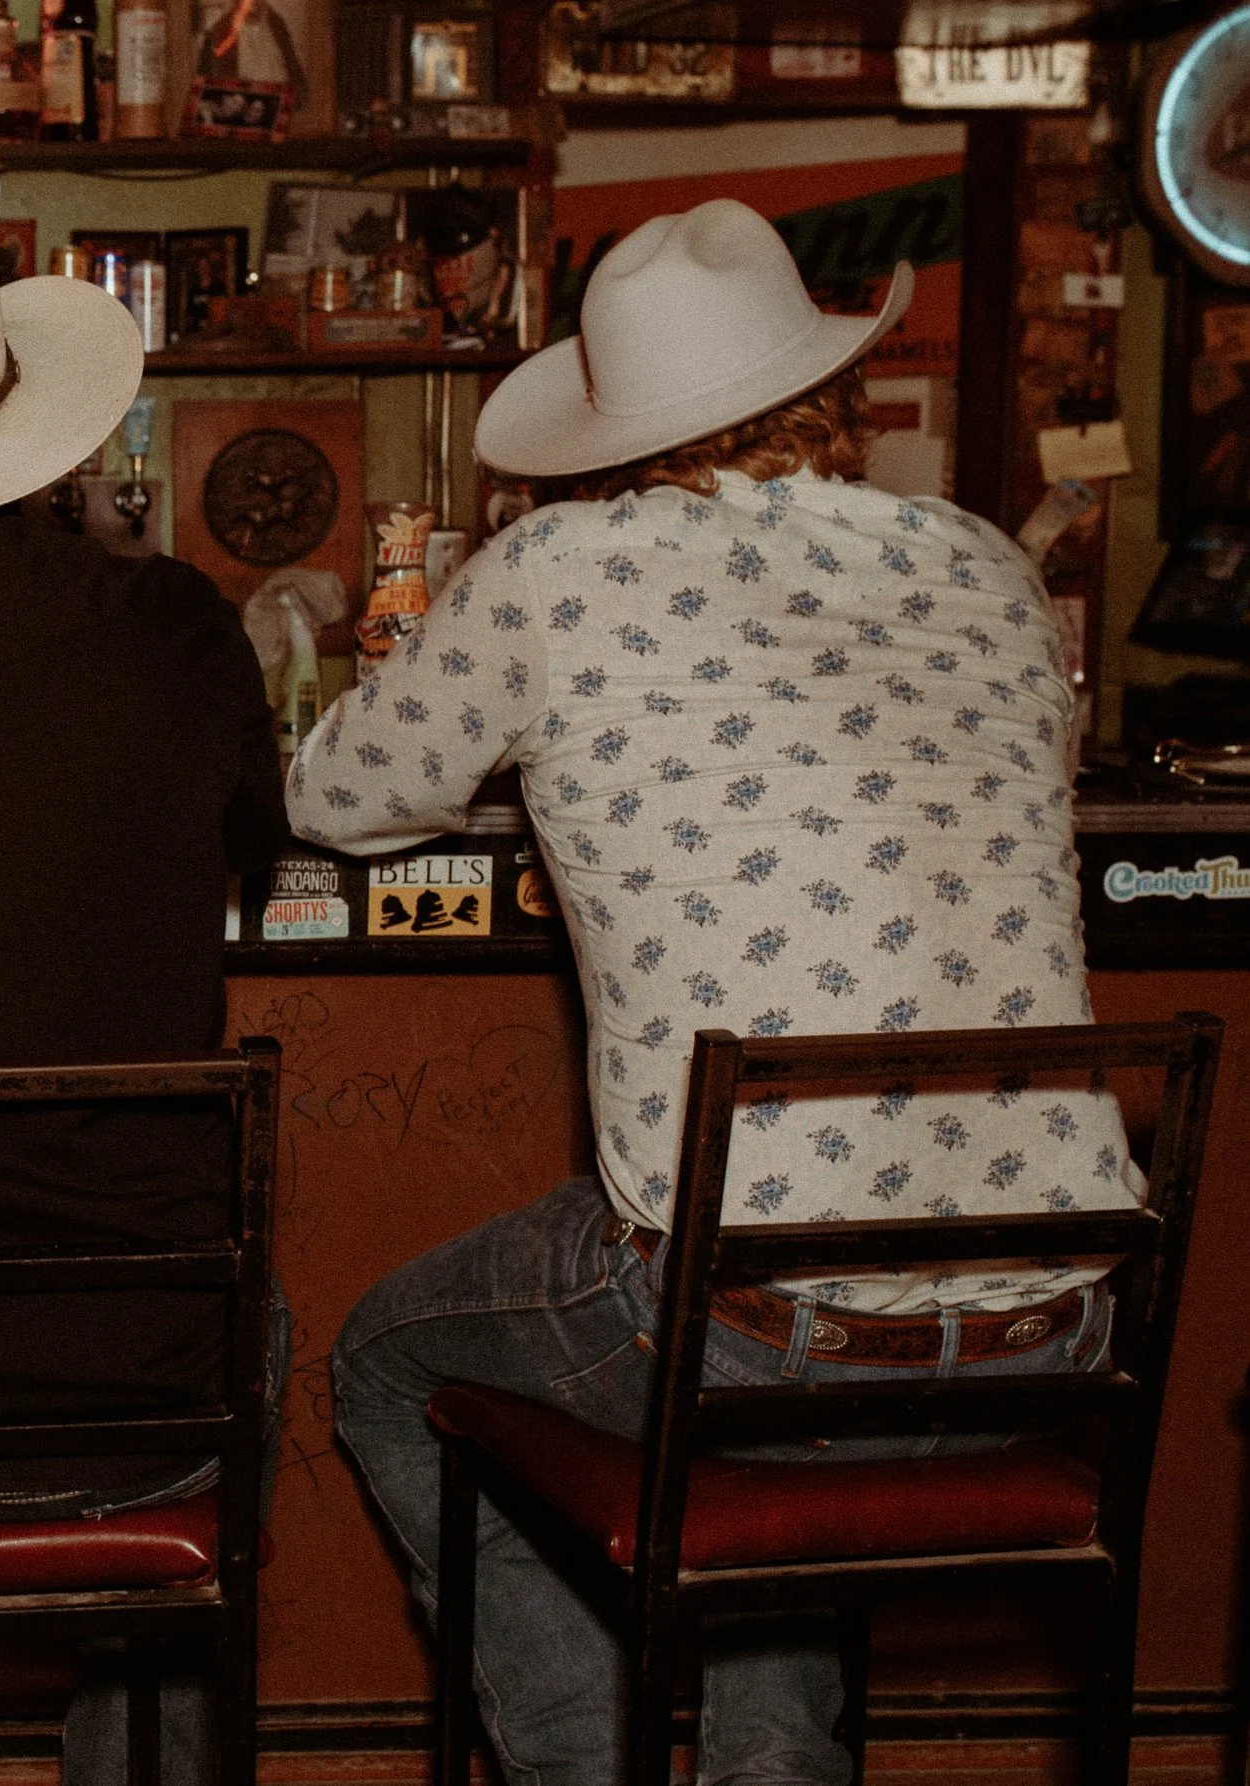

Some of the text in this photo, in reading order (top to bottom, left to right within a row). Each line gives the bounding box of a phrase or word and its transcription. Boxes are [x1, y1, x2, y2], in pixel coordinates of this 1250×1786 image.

[376, 859, 485, 885] BELL'S
[1108, 865, 1210, 897] Crooked
[265, 901, 328, 923] SHORTYS
